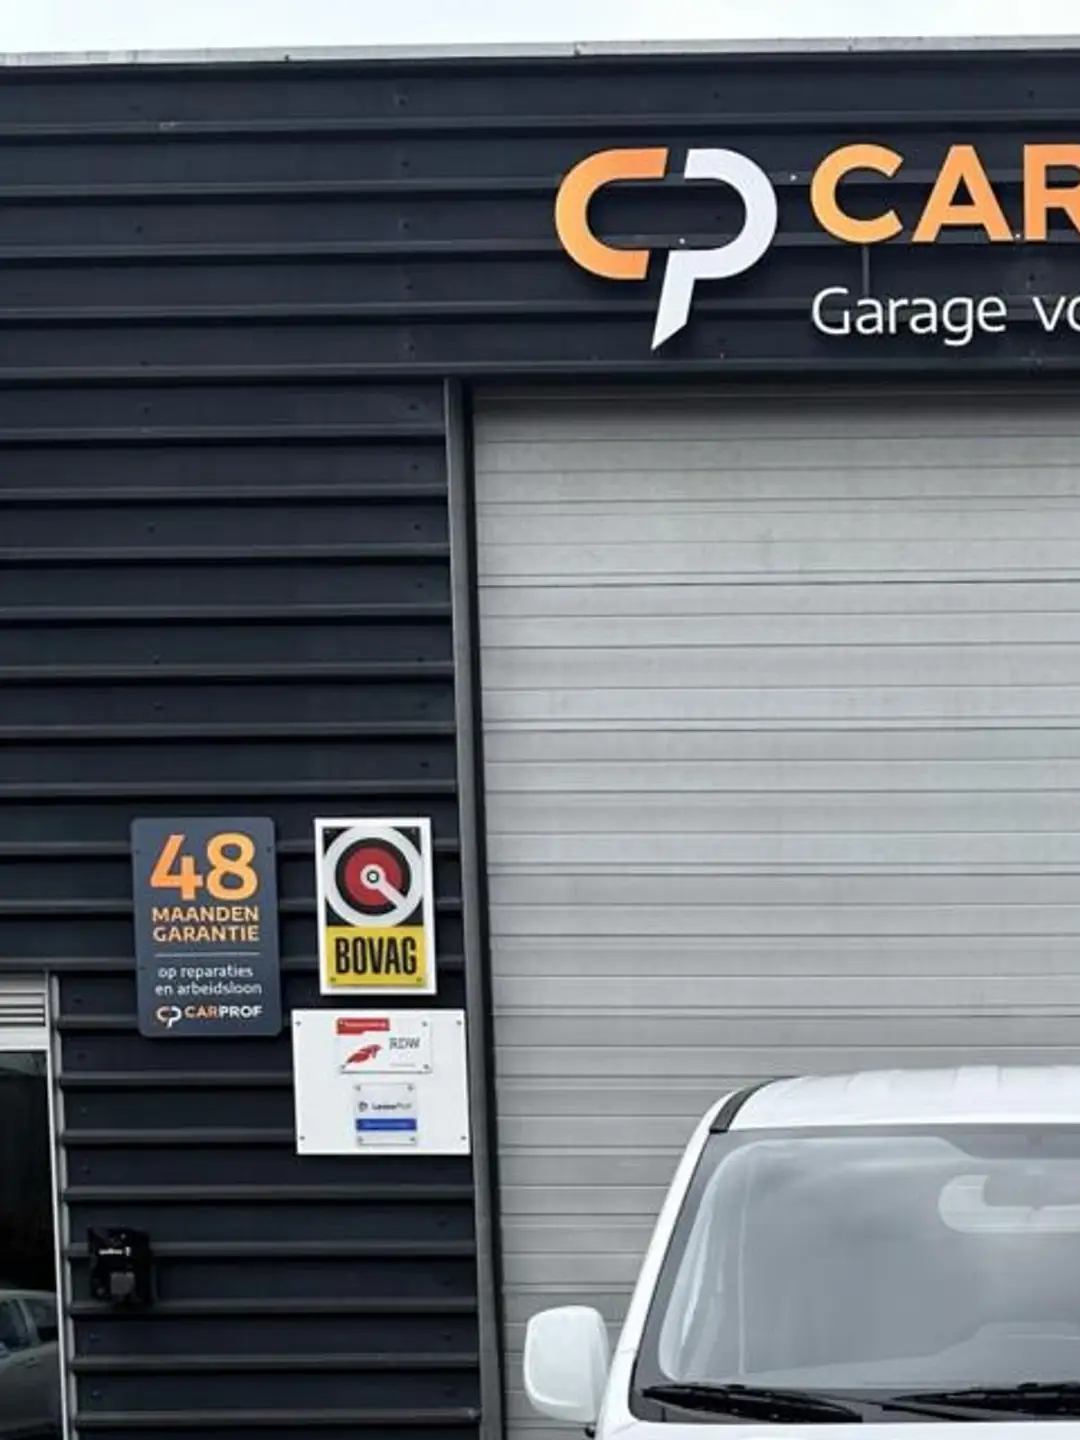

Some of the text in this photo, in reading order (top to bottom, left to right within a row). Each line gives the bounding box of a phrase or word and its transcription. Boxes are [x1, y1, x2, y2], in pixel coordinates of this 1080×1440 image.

[811, 286, 1007, 347] Garage
[151, 832, 260, 900] 48
[152, 906, 260, 922] MAANDEN
[153, 925, 260, 942] GARANTIE
[335, 936, 417, 975] BOVAG
[158, 963, 254, 980] op reparaties
[155, 981, 263, 995] en arbeidsloon
[184, 1005, 263, 1019] CARPROF
